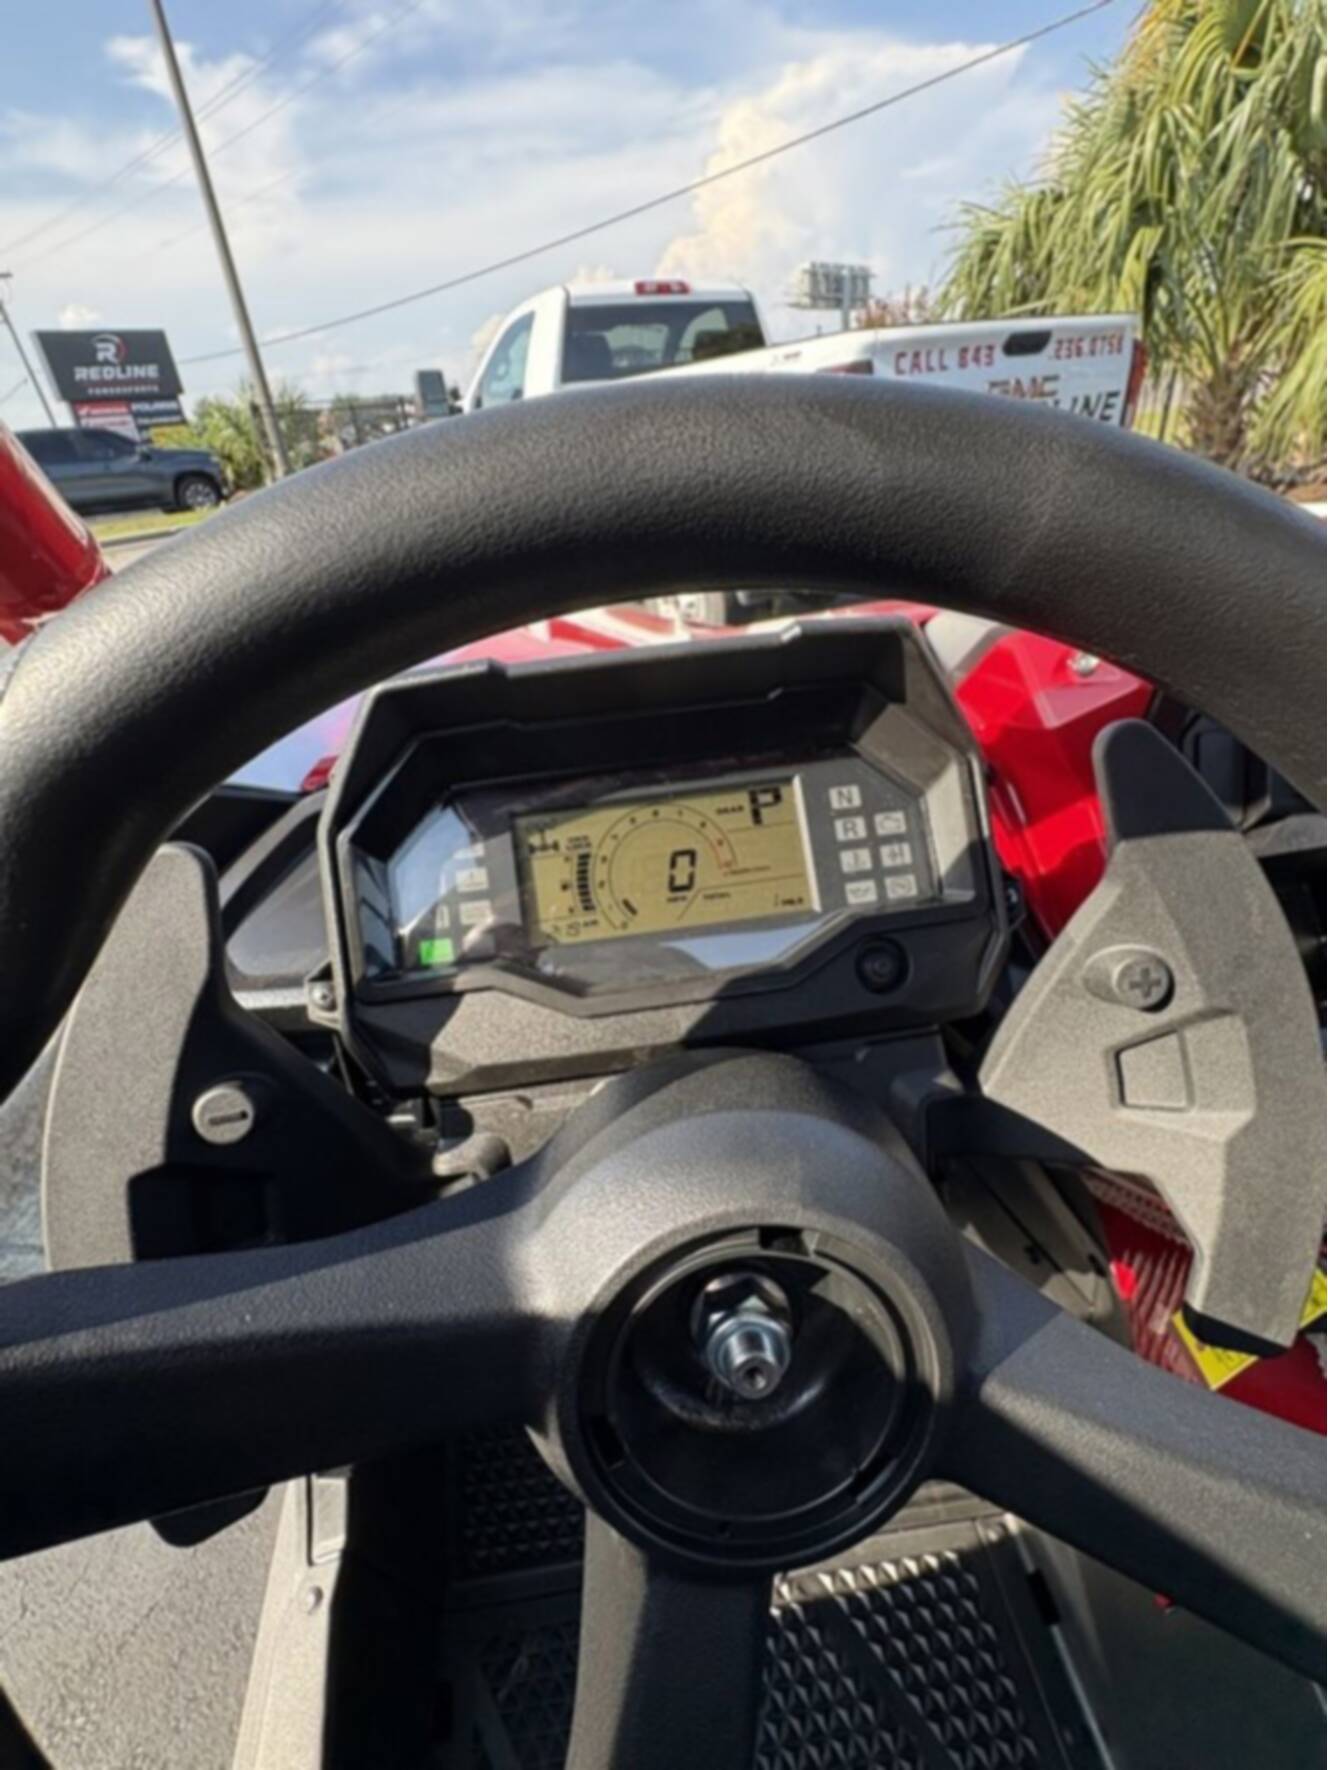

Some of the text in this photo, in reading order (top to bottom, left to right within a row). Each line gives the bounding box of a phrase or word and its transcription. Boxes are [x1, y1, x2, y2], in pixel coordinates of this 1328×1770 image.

[73, 364, 160, 382] REDLINE
[894, 349, 949, 376] CALL
[749, 786, 783, 827] P
[668, 848, 697, 894] 0
